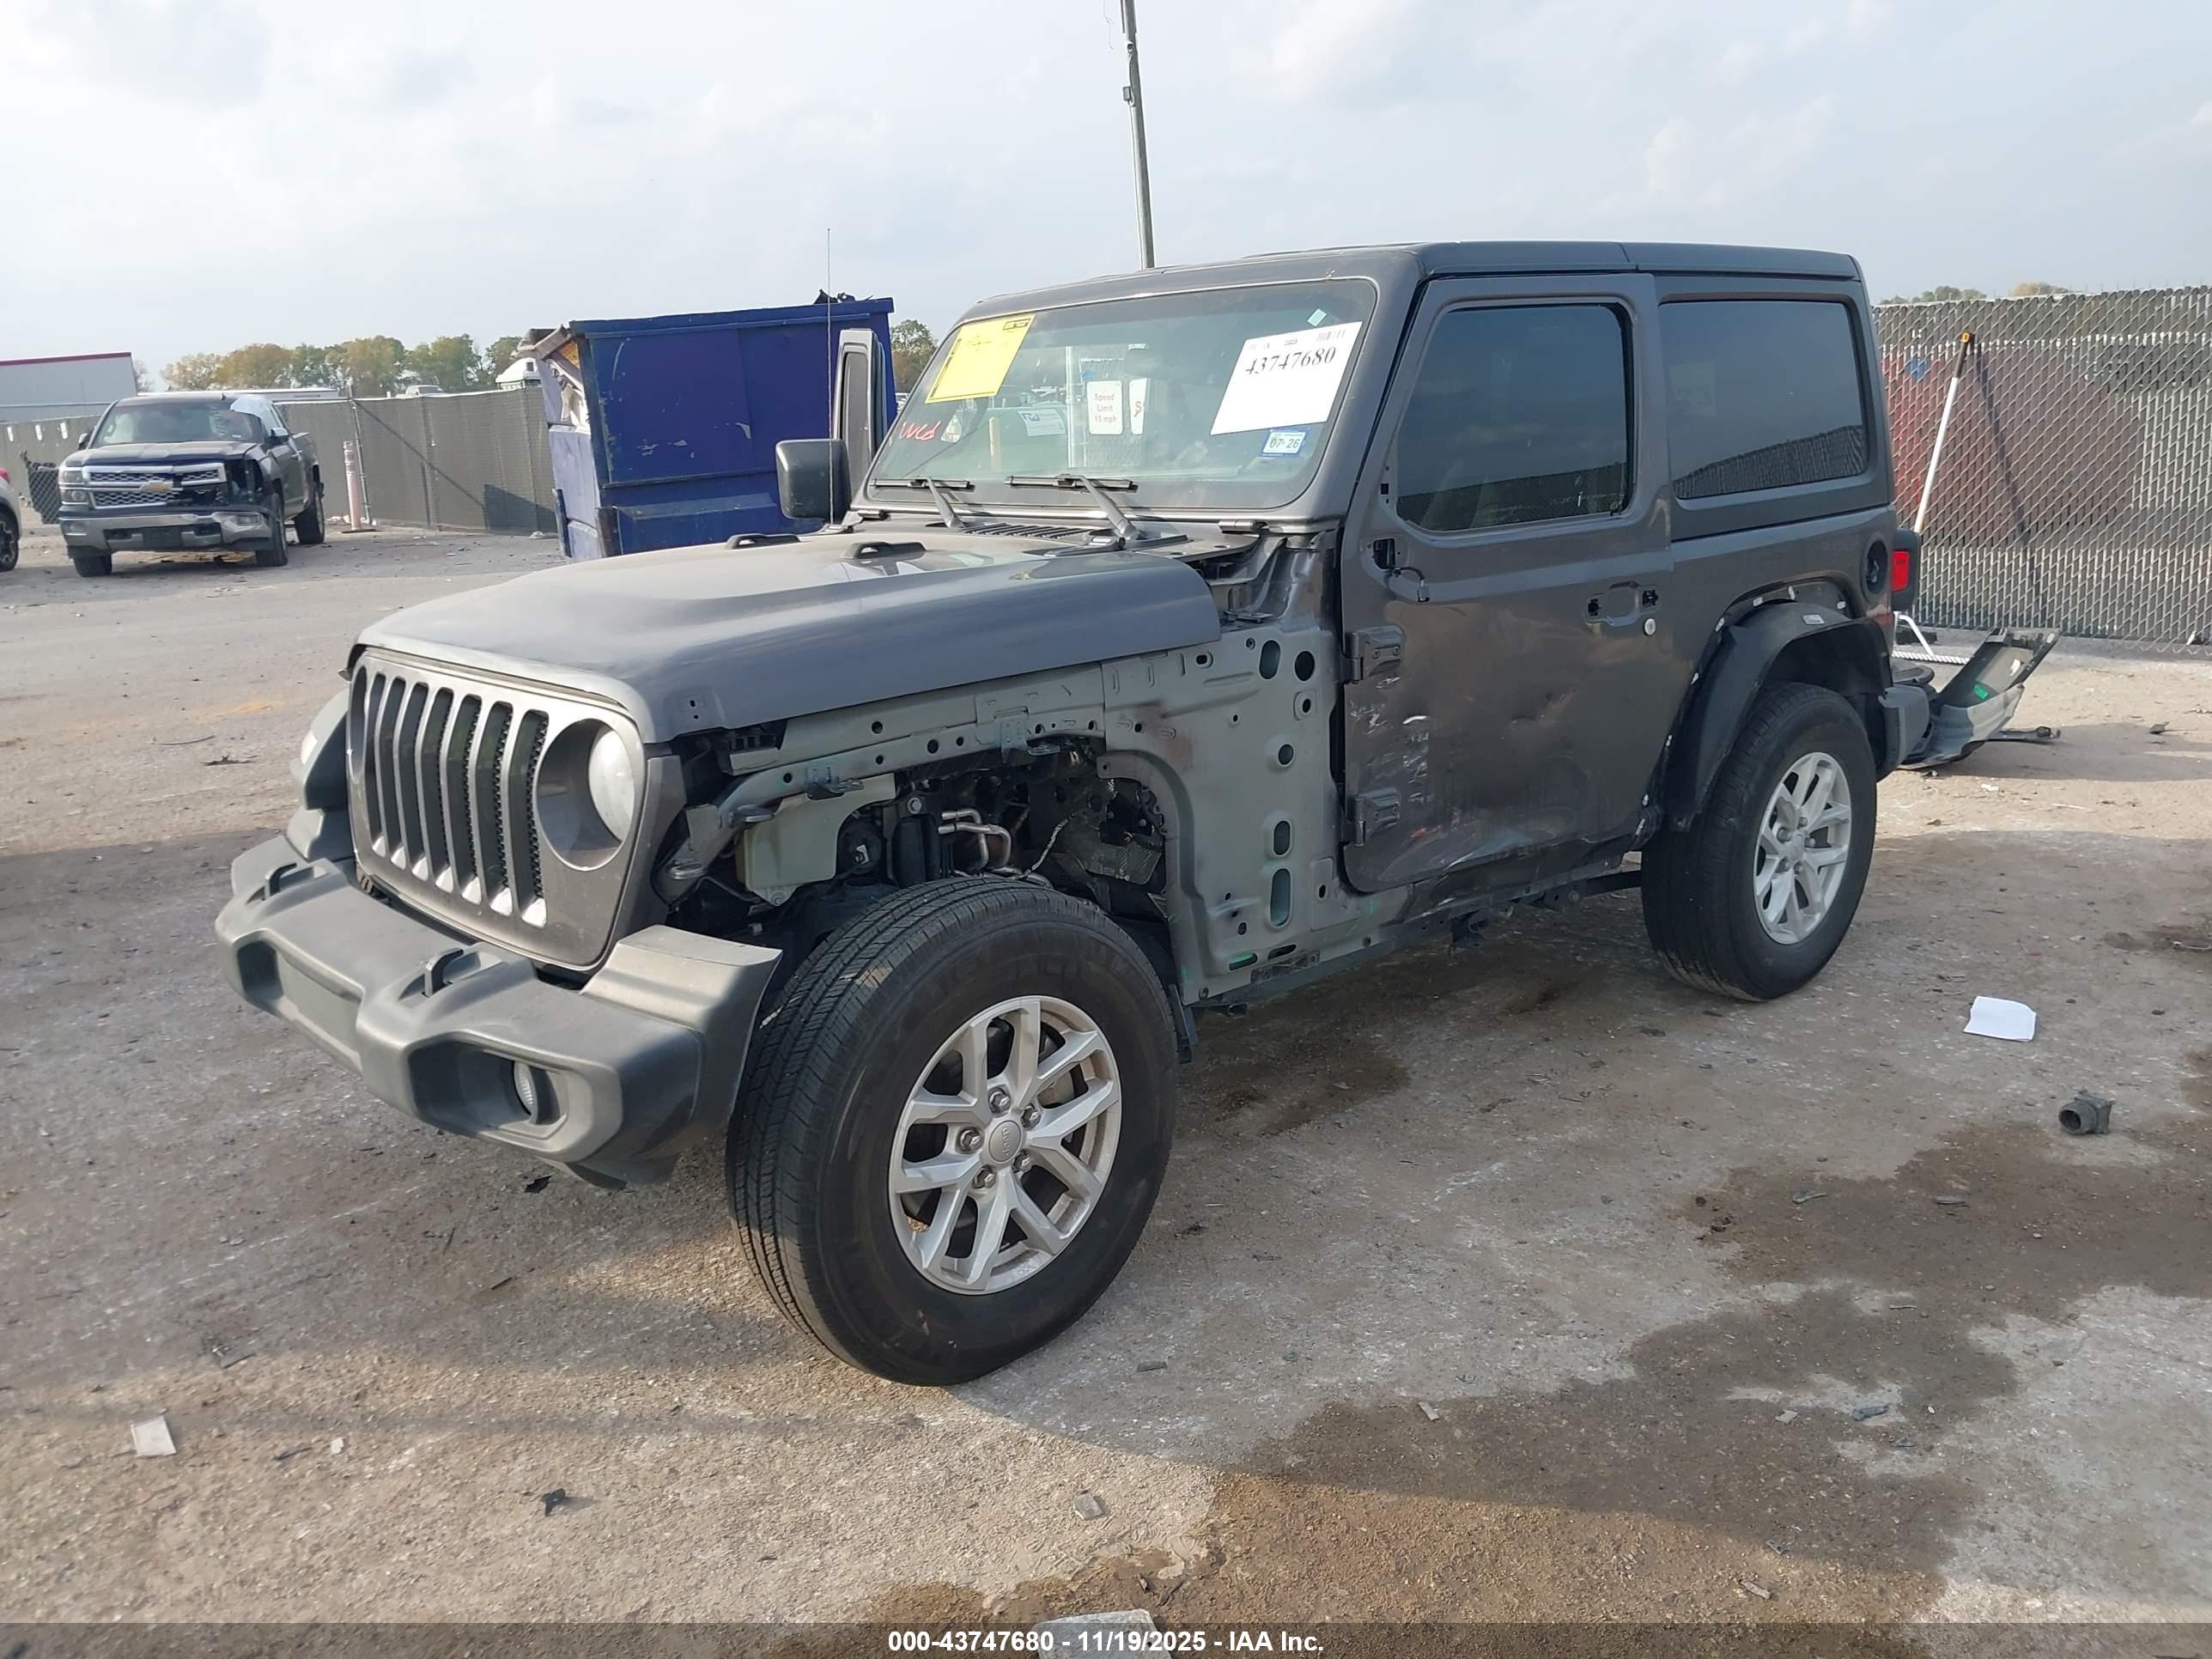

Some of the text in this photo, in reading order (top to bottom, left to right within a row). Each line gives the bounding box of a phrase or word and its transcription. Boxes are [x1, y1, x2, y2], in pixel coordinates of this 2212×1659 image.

[1245, 346, 1336, 374] 43747680
[1095, 393, 1115, 402] Speed
[1270, 438, 1300, 448] 07 26
